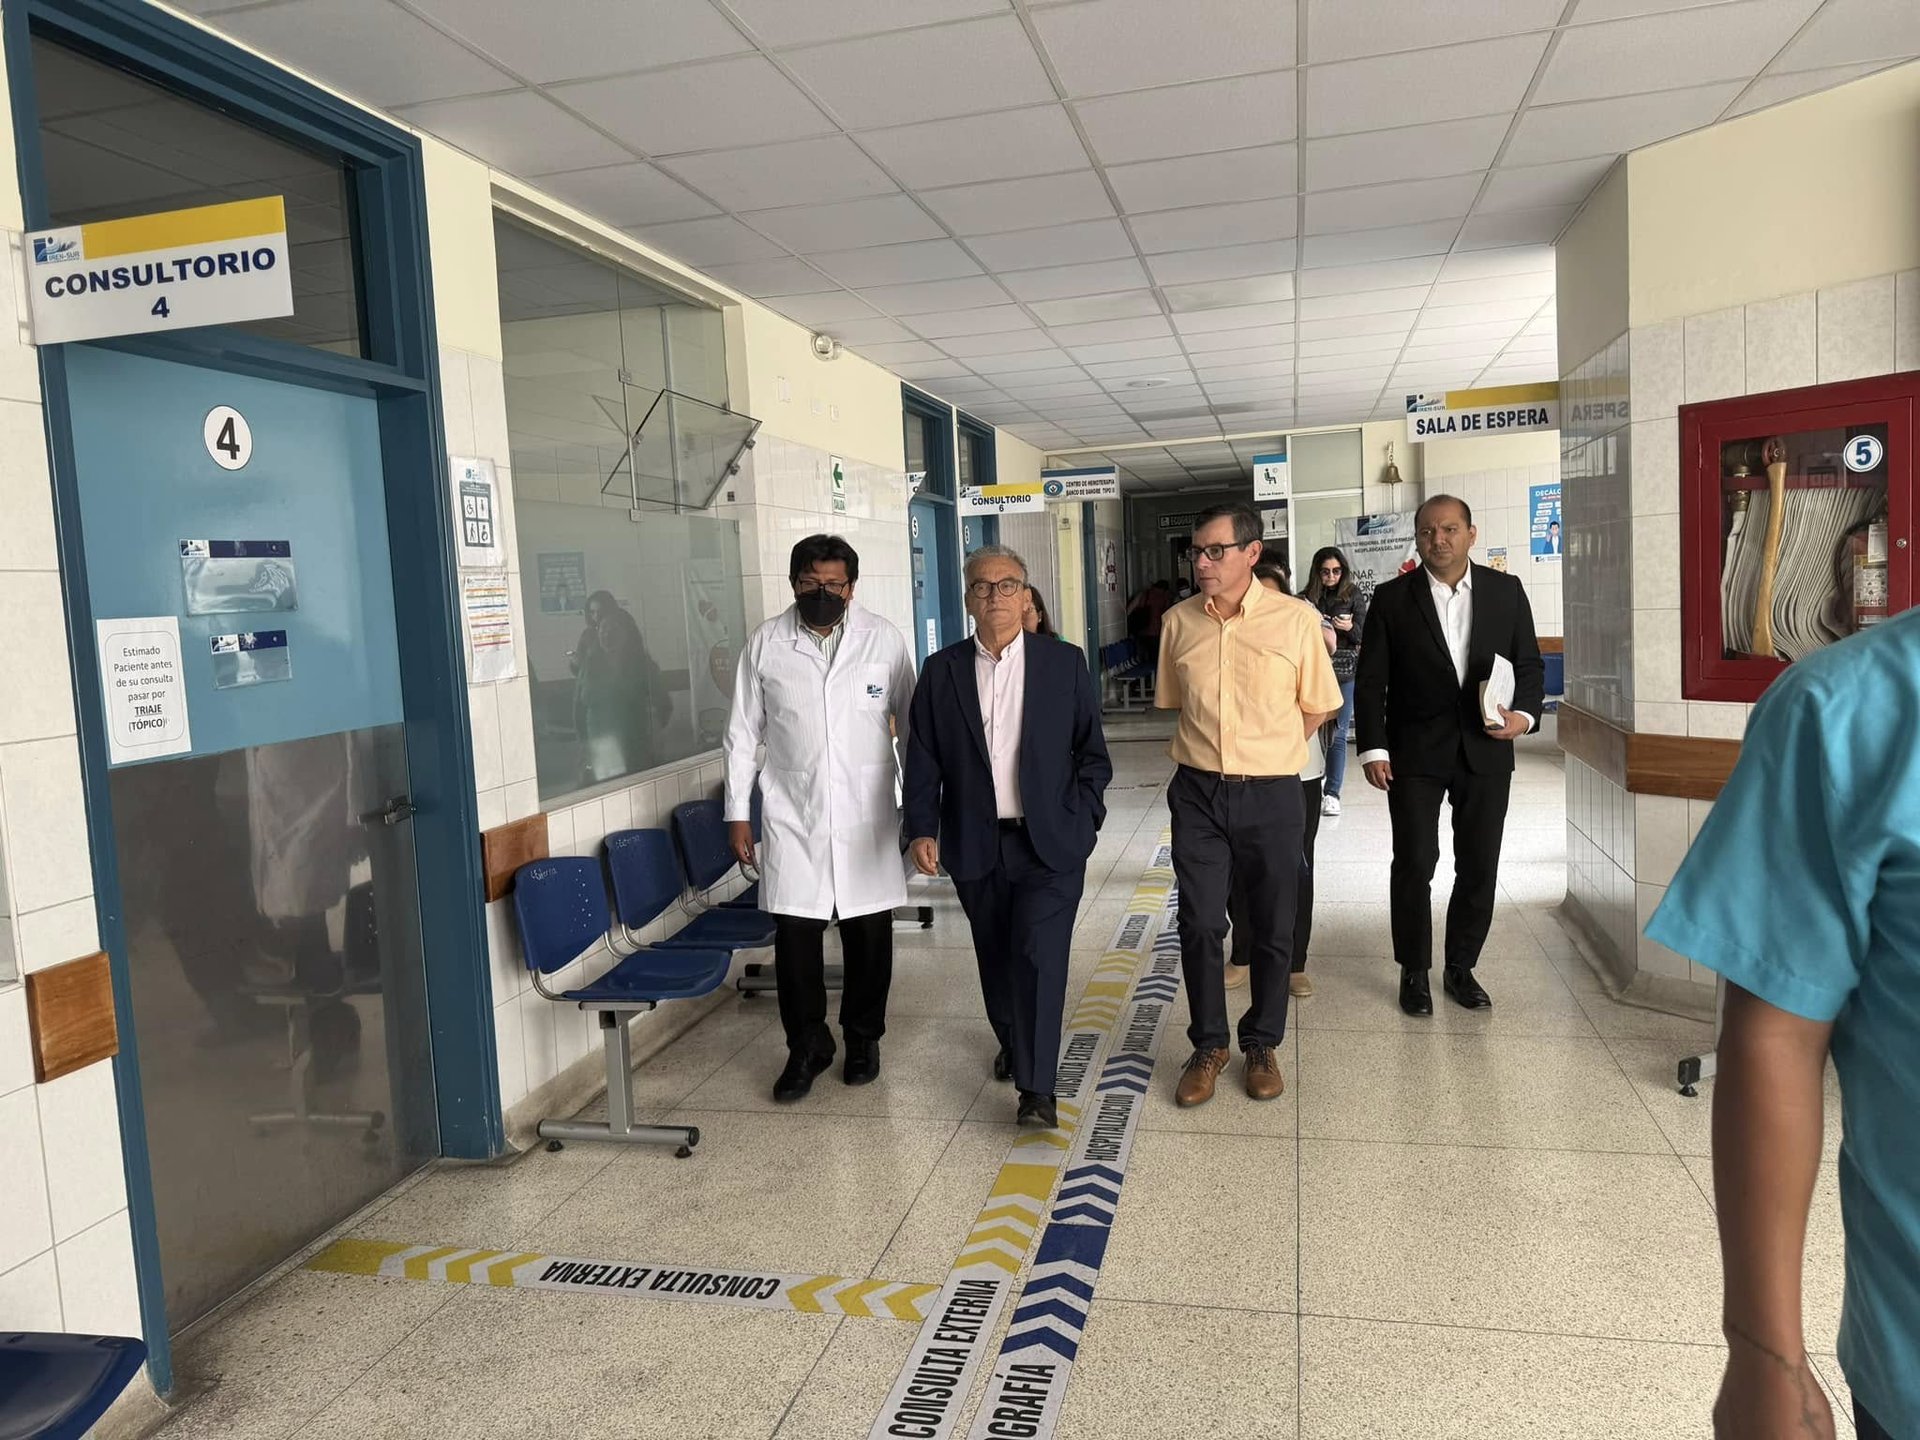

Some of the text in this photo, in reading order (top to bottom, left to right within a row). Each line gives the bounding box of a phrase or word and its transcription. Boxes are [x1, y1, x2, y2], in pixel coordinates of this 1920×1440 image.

[45, 247, 276, 298] CONSULTORIO
[151, 296, 170, 318] 4
[1416, 407, 1549, 435] SALA DE ESPERA
[217, 417, 240, 460] 4
[1856, 441, 1871, 466] 5
[972, 495, 1031, 505] CONSULTORIO
[1086, 487, 1101, 495] SANGRE
[123, 646, 160, 657] Estimado
[114, 660, 173, 672] Paciente antes
[116, 678, 127, 687] de
[140, 674, 173, 685] consulta
[128, 689, 165, 703] pasar por
[134, 704, 162, 716] TRIAJE
[128, 718, 166, 733] (TÓPICO)
[1132, 1003, 1164, 1025] SANGRE
[1121, 1032, 1153, 1051] BANCO
[1053, 1033, 1100, 1098] CONSULTA EXTERNA
[539, 1260, 781, 1300] CONSULTA EXTERNA
[888, 1279, 1001, 1439] CONSULTA EXTERNA
[983, 1364, 1056, 1440] GRAFÍA
